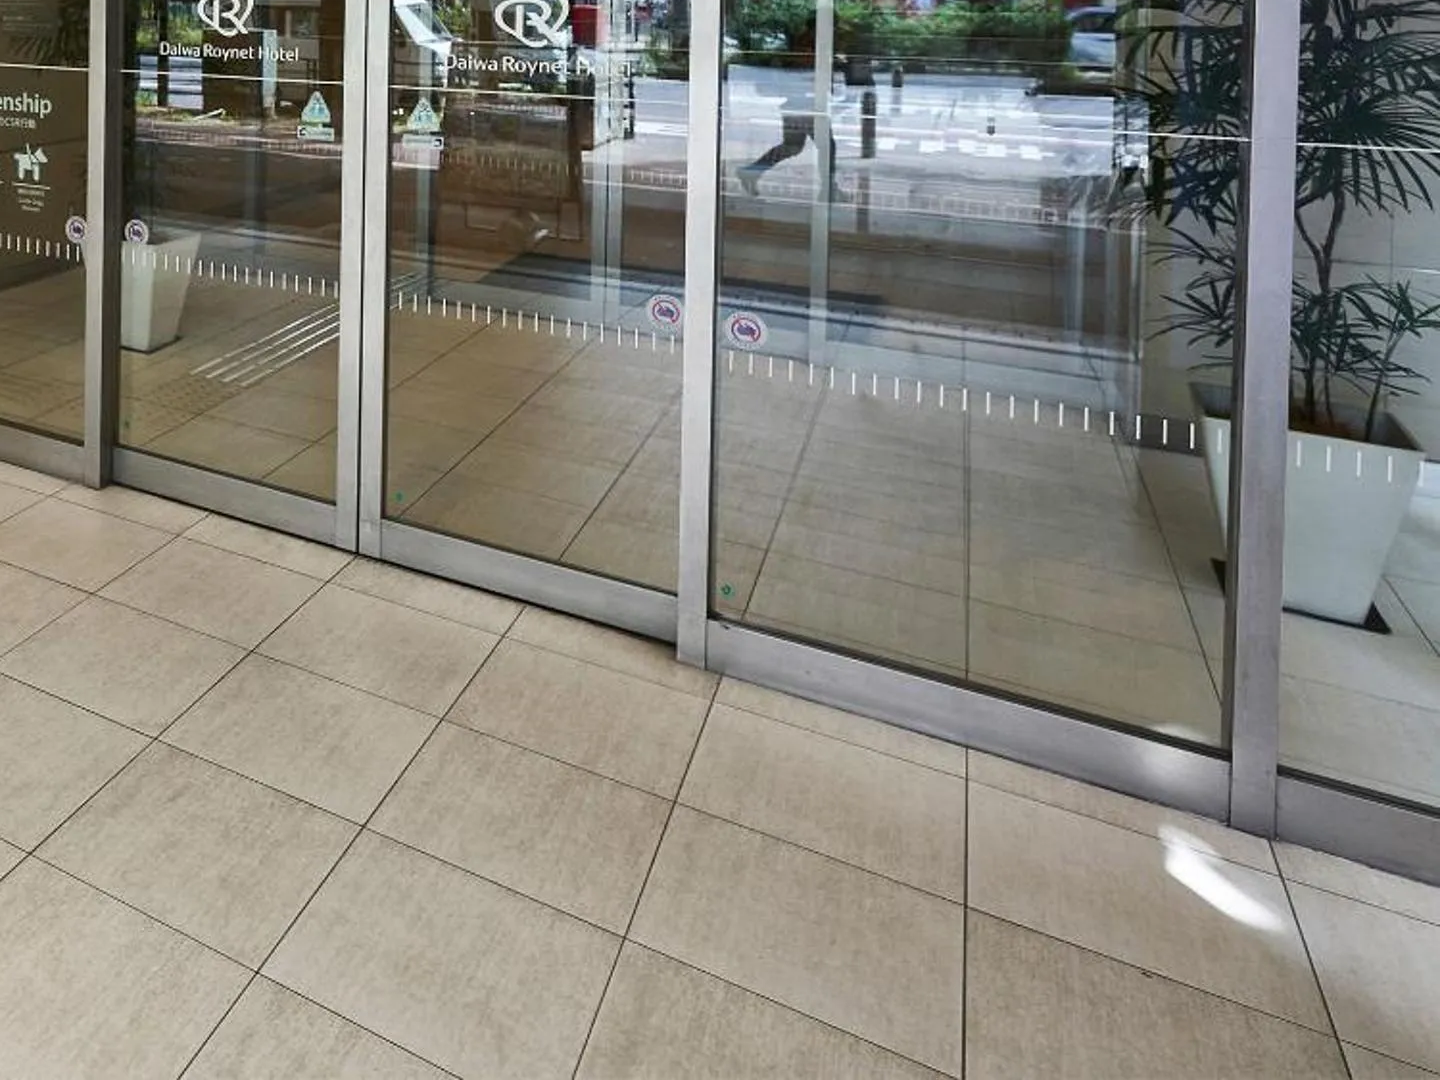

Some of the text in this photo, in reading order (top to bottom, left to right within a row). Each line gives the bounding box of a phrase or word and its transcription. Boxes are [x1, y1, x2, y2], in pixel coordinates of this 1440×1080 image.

[160, 41, 299, 62] Daiwa Roynet Hotel
[444, 54, 498, 71] Daiwa
[502, 56, 570, 77] Roynet
